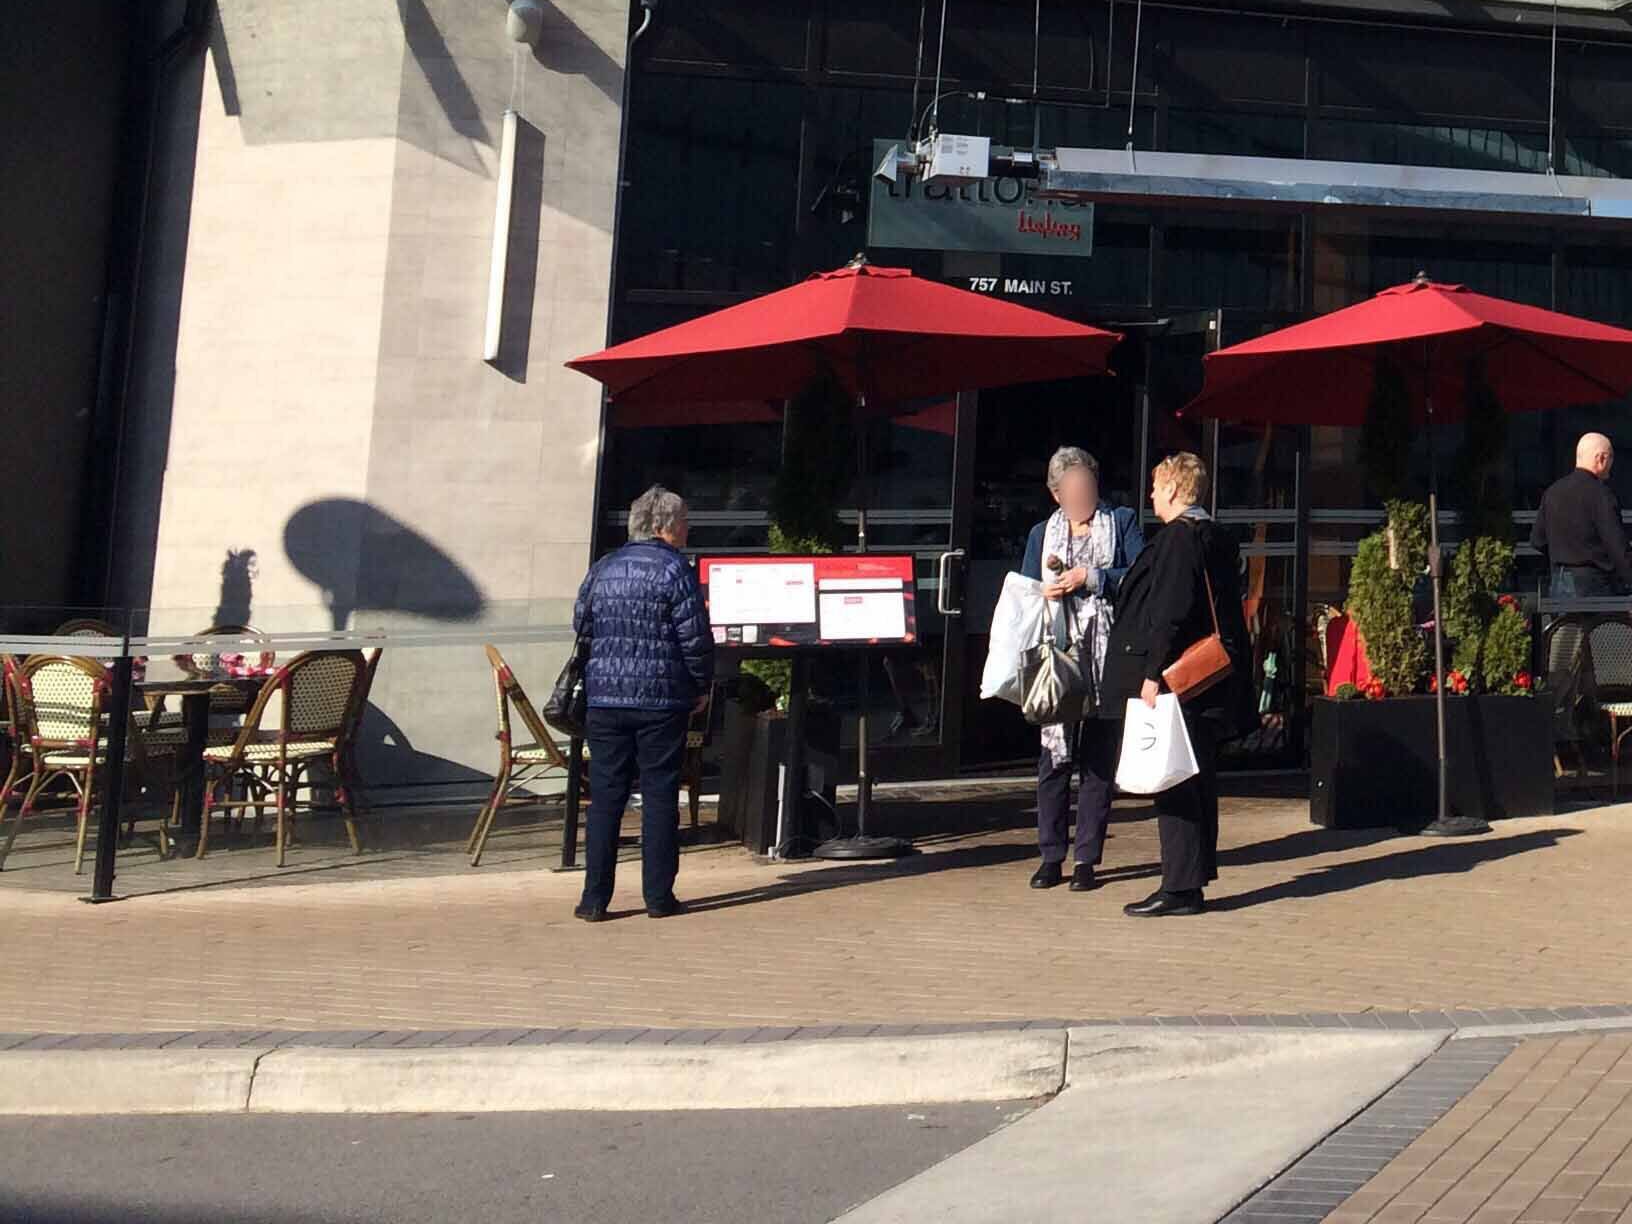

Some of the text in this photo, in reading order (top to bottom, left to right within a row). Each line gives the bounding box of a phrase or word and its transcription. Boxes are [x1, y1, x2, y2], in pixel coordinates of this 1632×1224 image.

[969, 277, 1073, 295] 757 MAIN ST.
